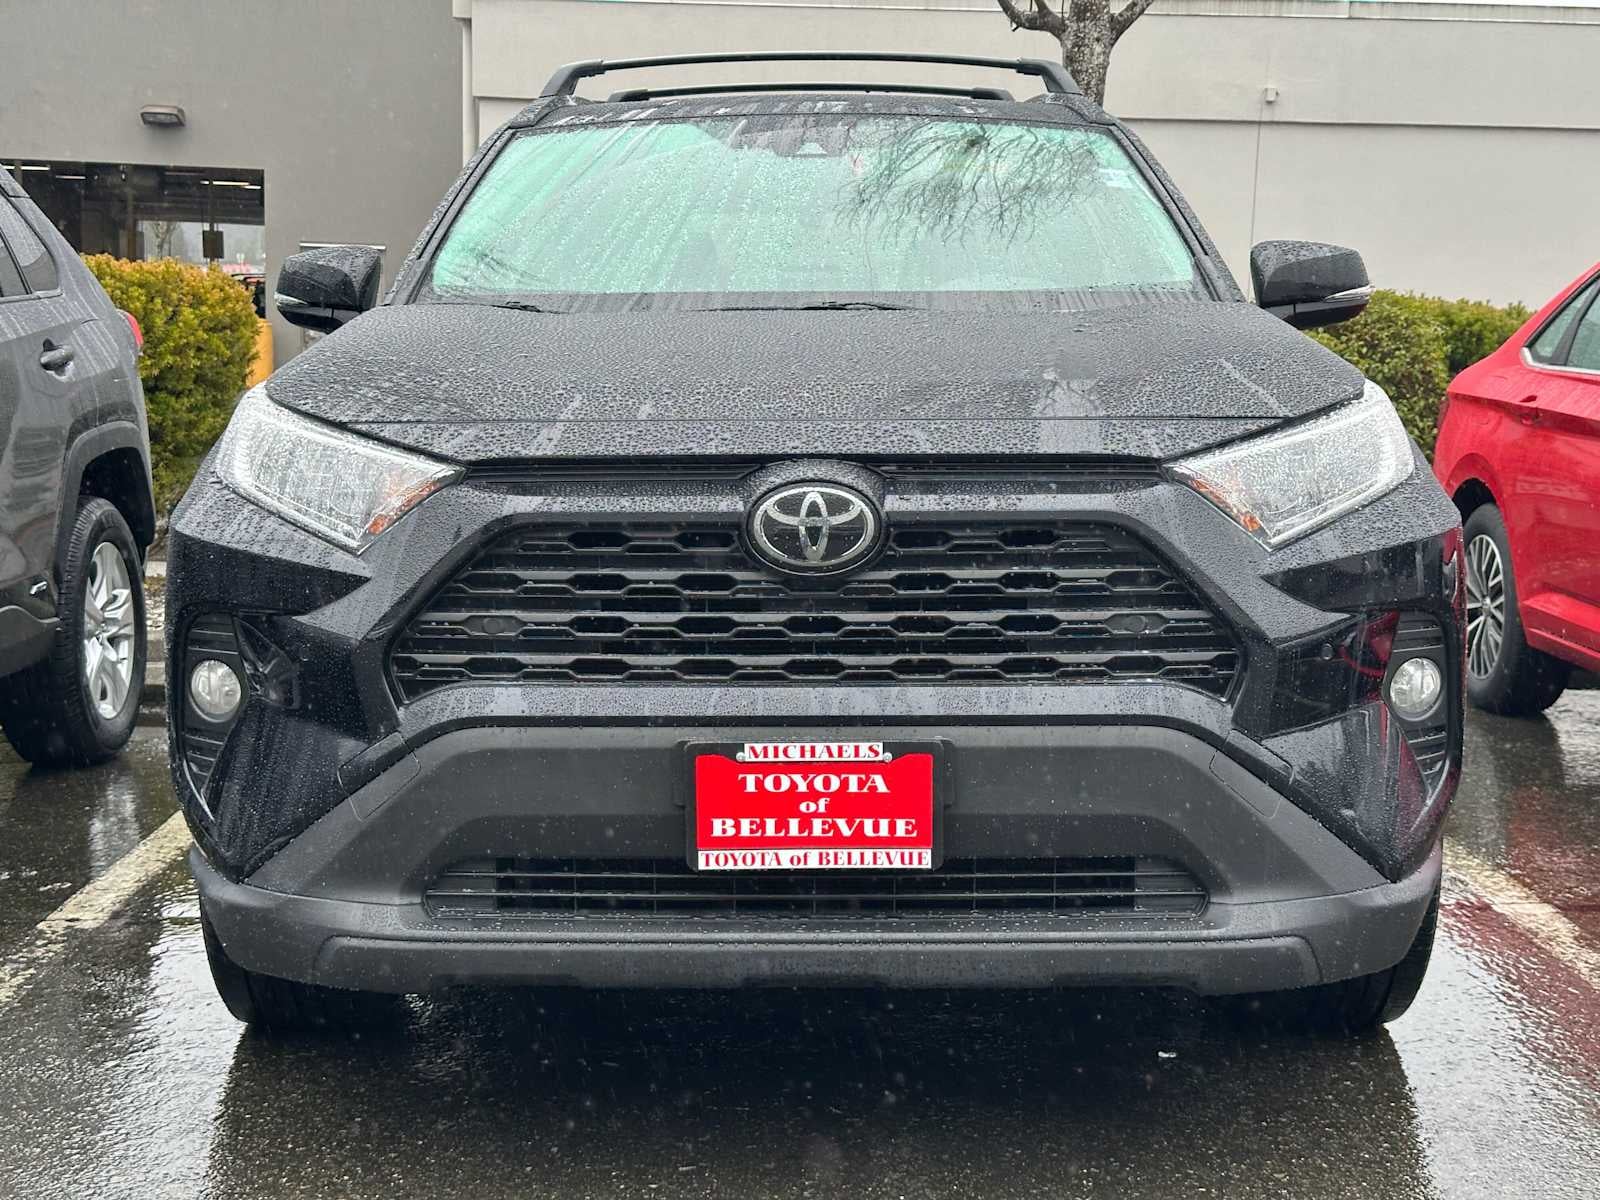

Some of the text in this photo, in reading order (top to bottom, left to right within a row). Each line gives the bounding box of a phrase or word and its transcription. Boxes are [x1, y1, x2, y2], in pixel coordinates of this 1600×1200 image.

[748, 745, 880, 759] MICHAELS
[738, 773, 890, 793] TOYOTA
[800, 798, 830, 813] of
[711, 818, 917, 837] BELLEVUE
[701, 851, 929, 867] TOYOTA of BELLEVUE
